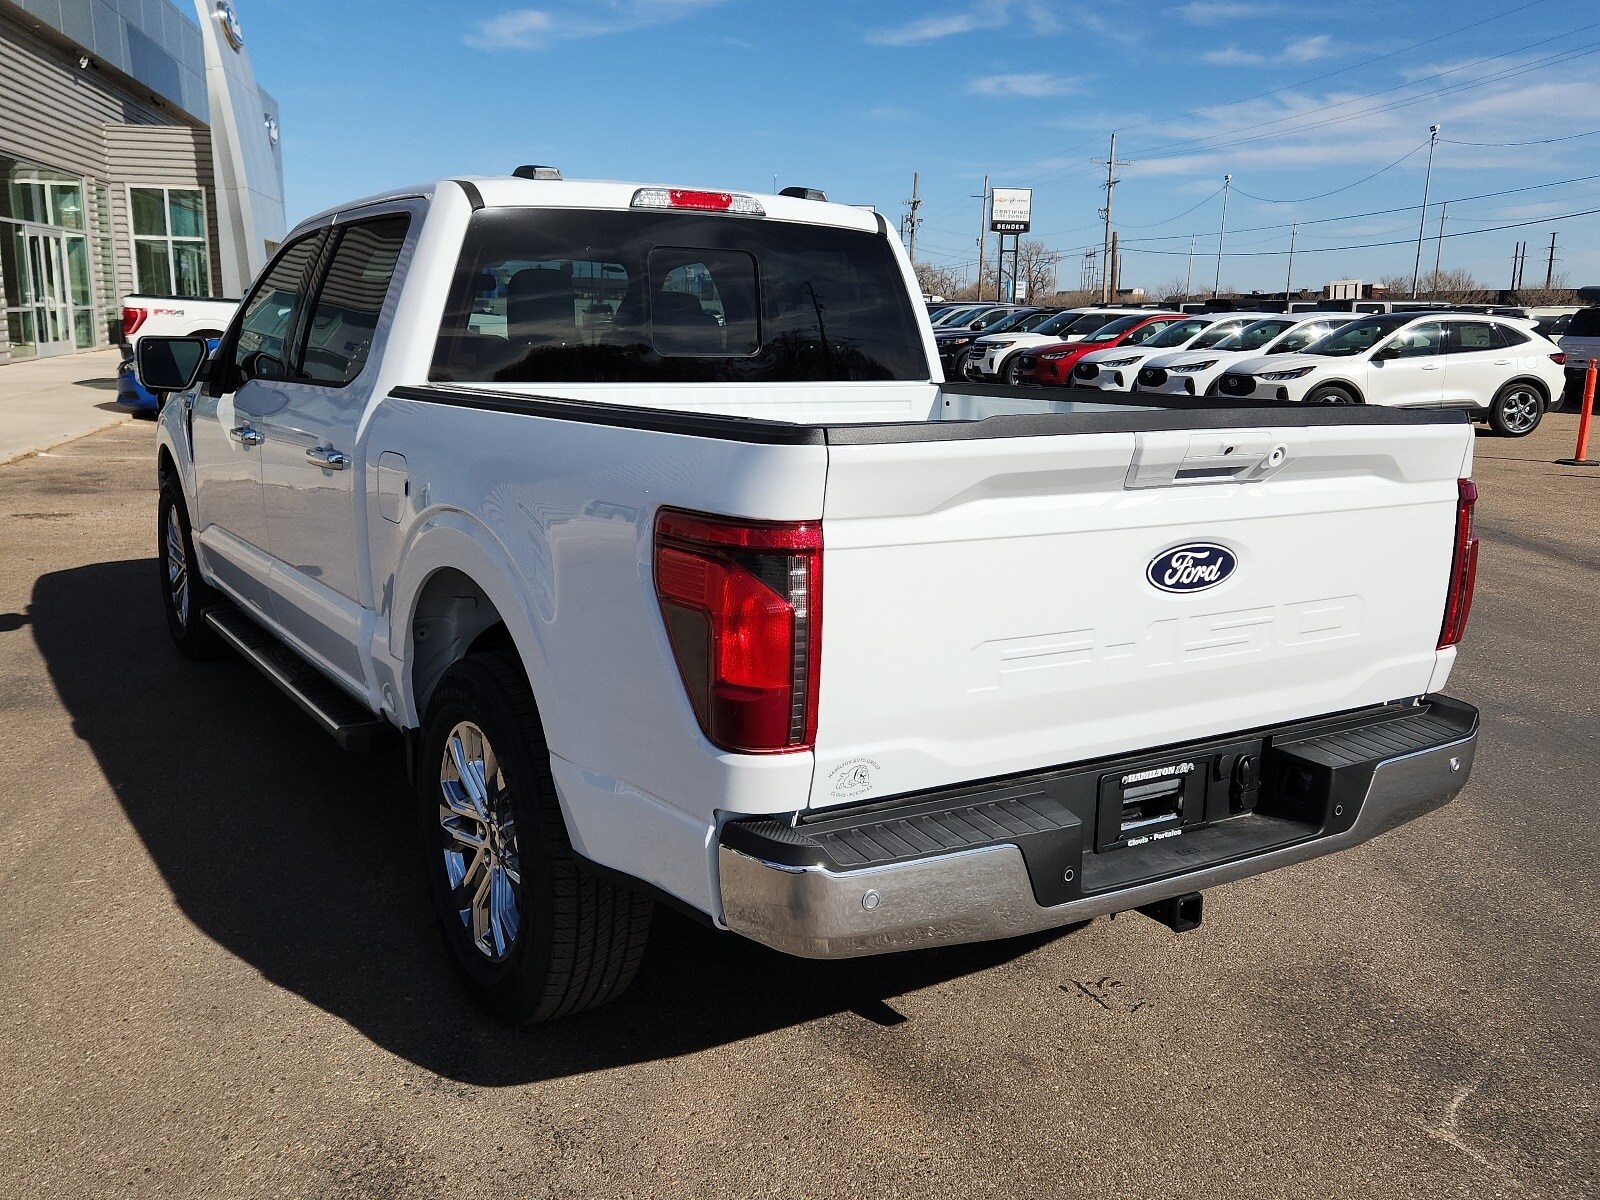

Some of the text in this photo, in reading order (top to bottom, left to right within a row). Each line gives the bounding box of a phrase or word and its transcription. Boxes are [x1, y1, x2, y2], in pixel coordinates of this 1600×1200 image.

[1163, 550, 1224, 586] Ford
[965, 593, 1364, 693] F-150
[828, 761, 852, 778] HAMILTON
[1127, 766, 1175, 783] HAMILTON
[1127, 829, 1182, 847] Clovis Portales
